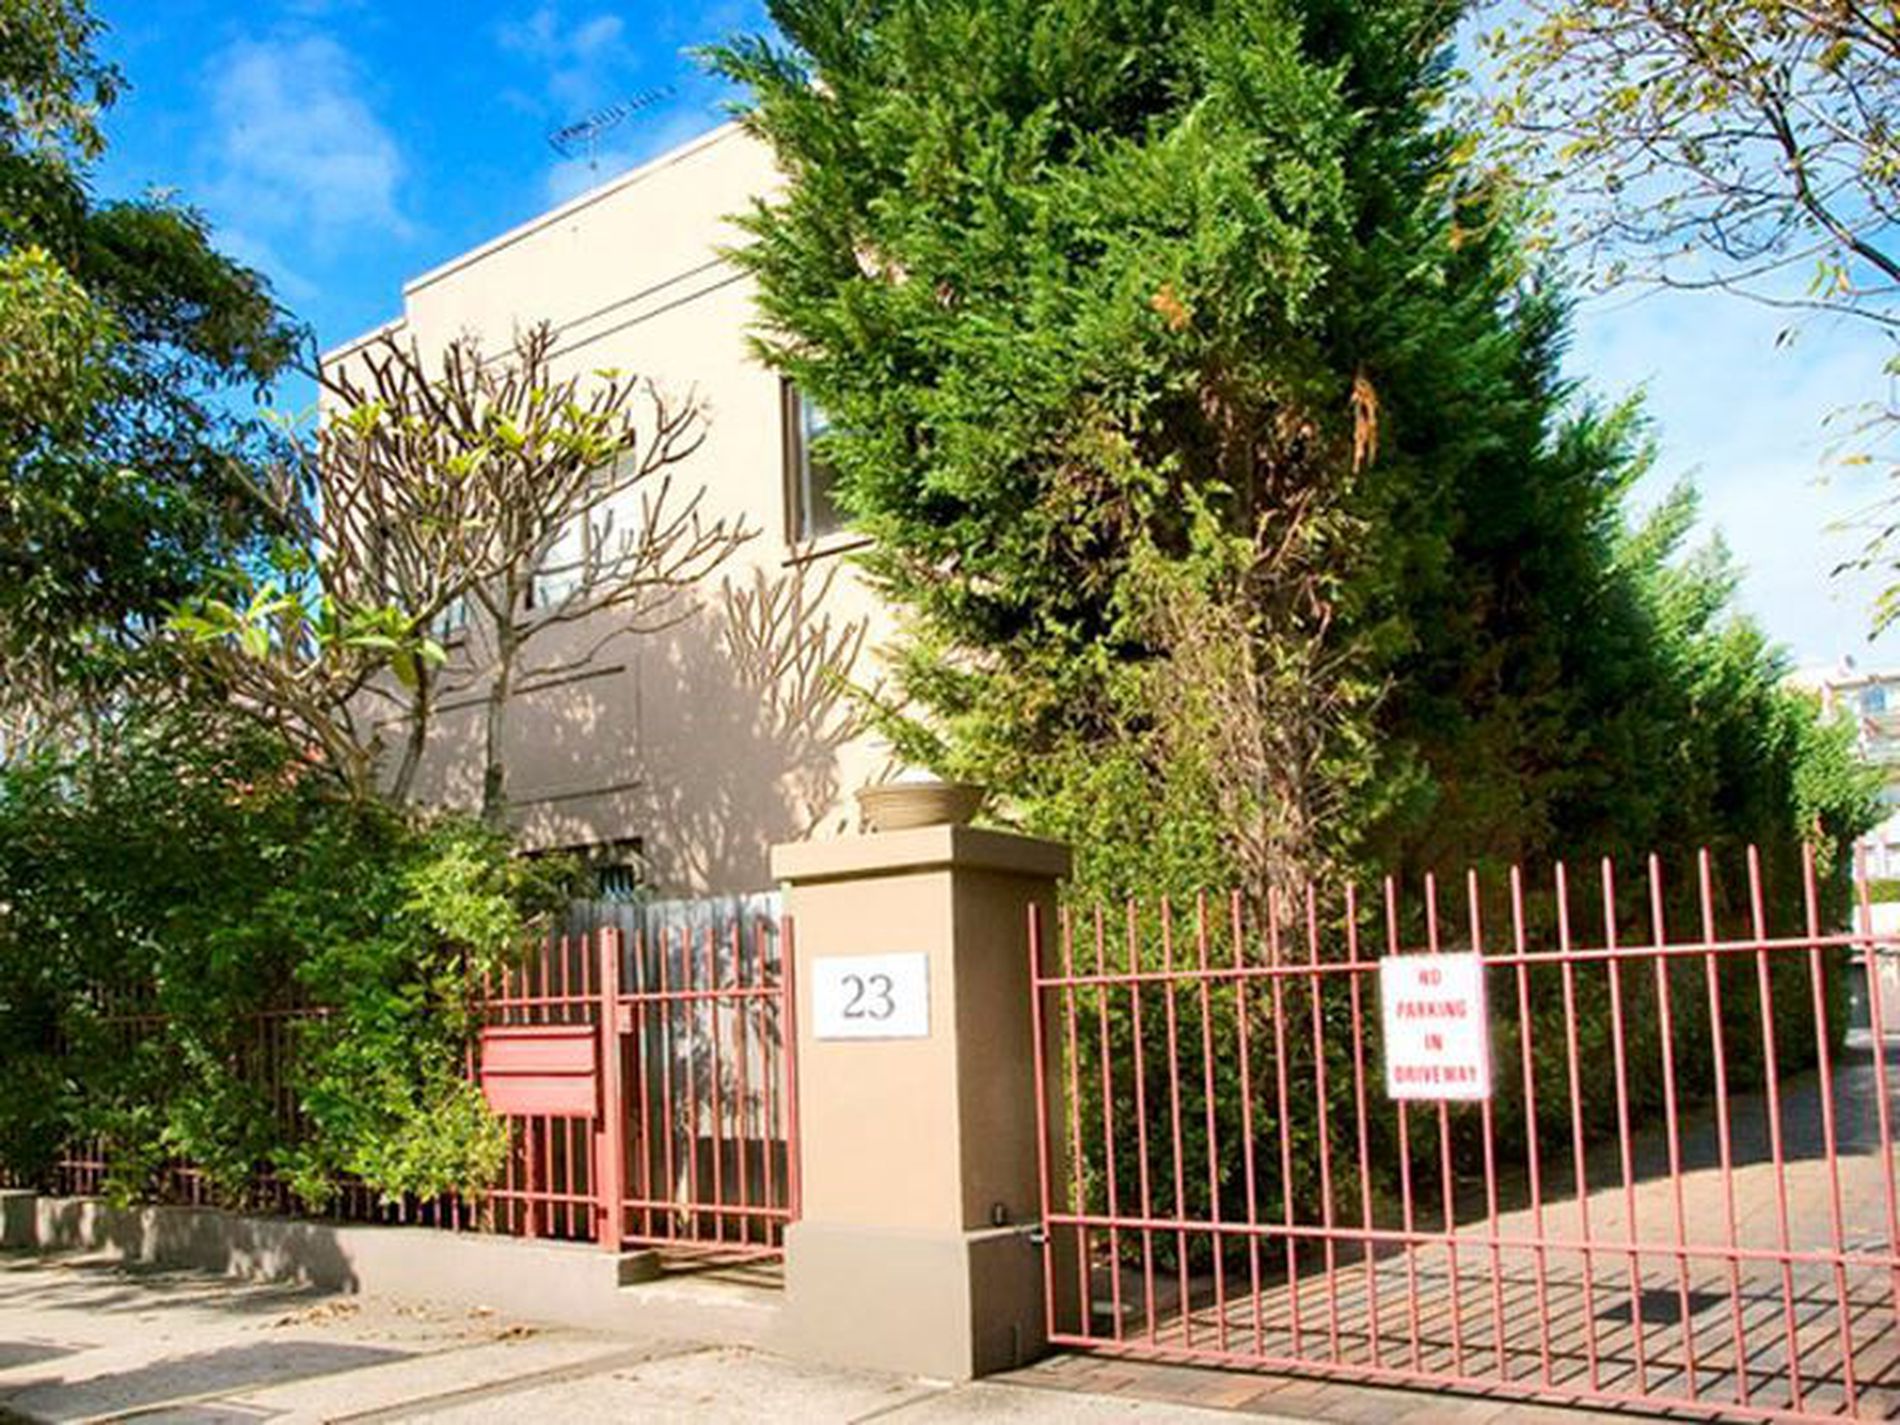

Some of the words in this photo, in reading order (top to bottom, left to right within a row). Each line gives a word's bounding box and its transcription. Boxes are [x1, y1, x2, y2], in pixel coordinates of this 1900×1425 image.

[1418, 968, 1442, 986] NO
[841, 973, 896, 1020] 23
[1396, 999, 1467, 1018] PARKING
[1424, 1033, 1443, 1051] IN
[1394, 1065, 1477, 1084] DRIVEWAY
